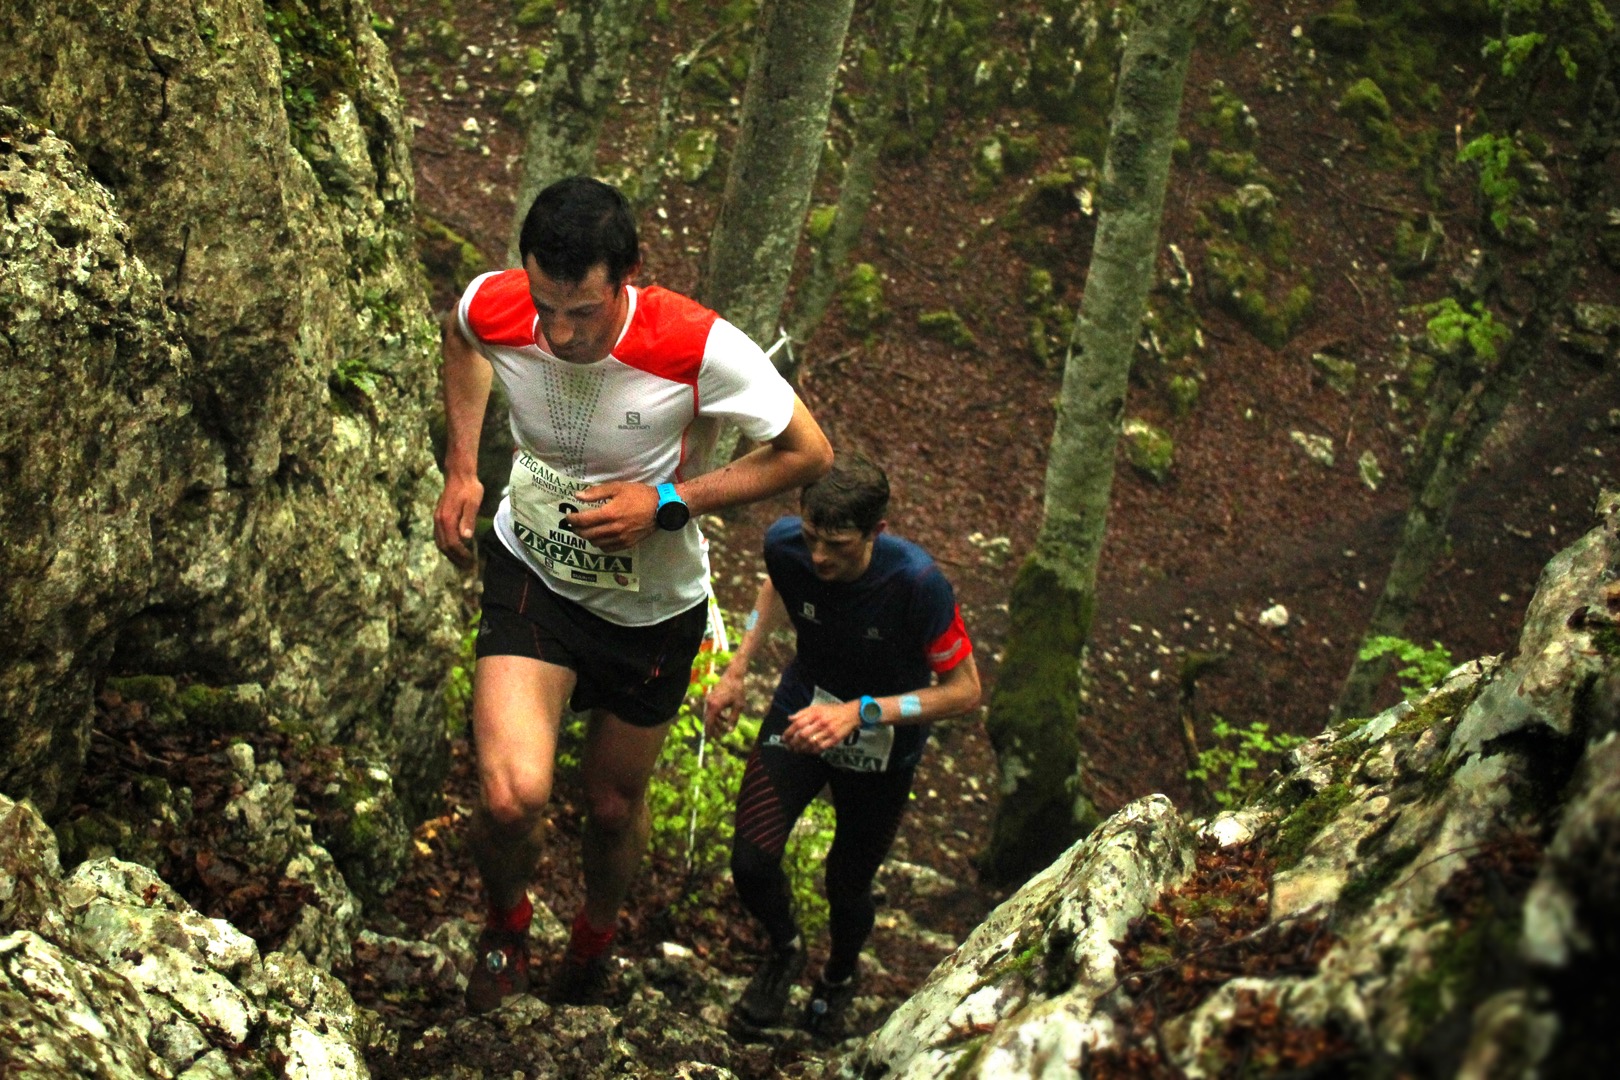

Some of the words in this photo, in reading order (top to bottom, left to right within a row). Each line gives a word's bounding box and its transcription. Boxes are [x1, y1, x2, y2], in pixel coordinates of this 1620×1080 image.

[532, 474, 557, 492] MENDI
[516, 525, 627, 572] ZEGAMA
[549, 529, 587, 550] KILIAN
